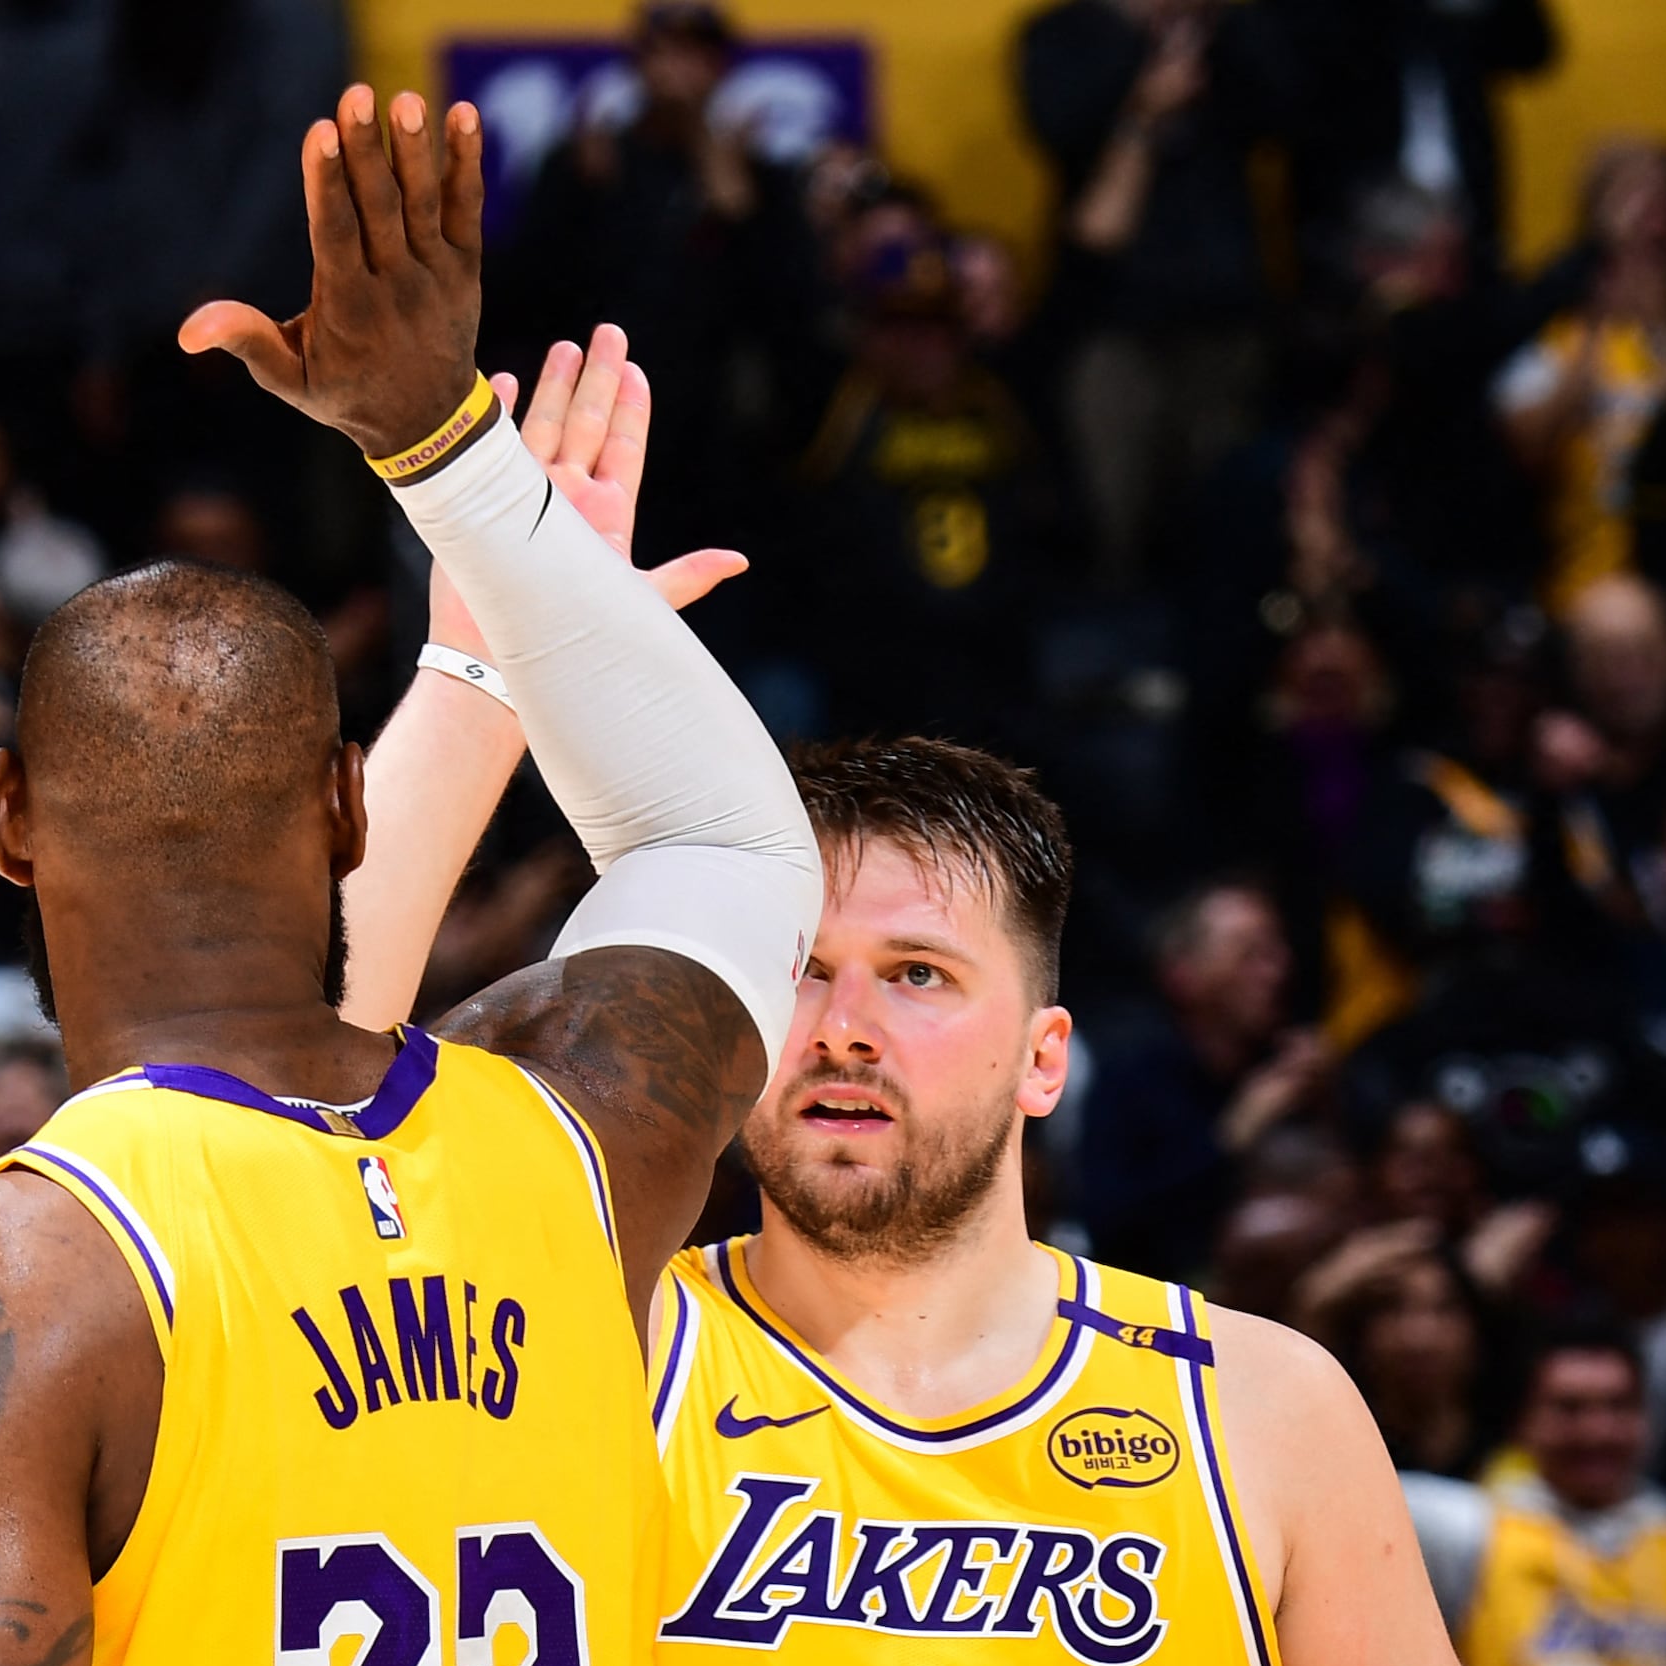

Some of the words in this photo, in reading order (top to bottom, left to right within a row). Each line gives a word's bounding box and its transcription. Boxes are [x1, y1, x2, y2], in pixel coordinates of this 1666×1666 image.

[384, 464, 394, 475] I
[395, 410, 474, 472] PROMISE
[290, 1274, 527, 1431] JAMES
[1118, 1325, 1157, 1347] 44
[1058, 1428, 1172, 1464] bibigo
[1083, 1456, 1132, 1471] 비비고
